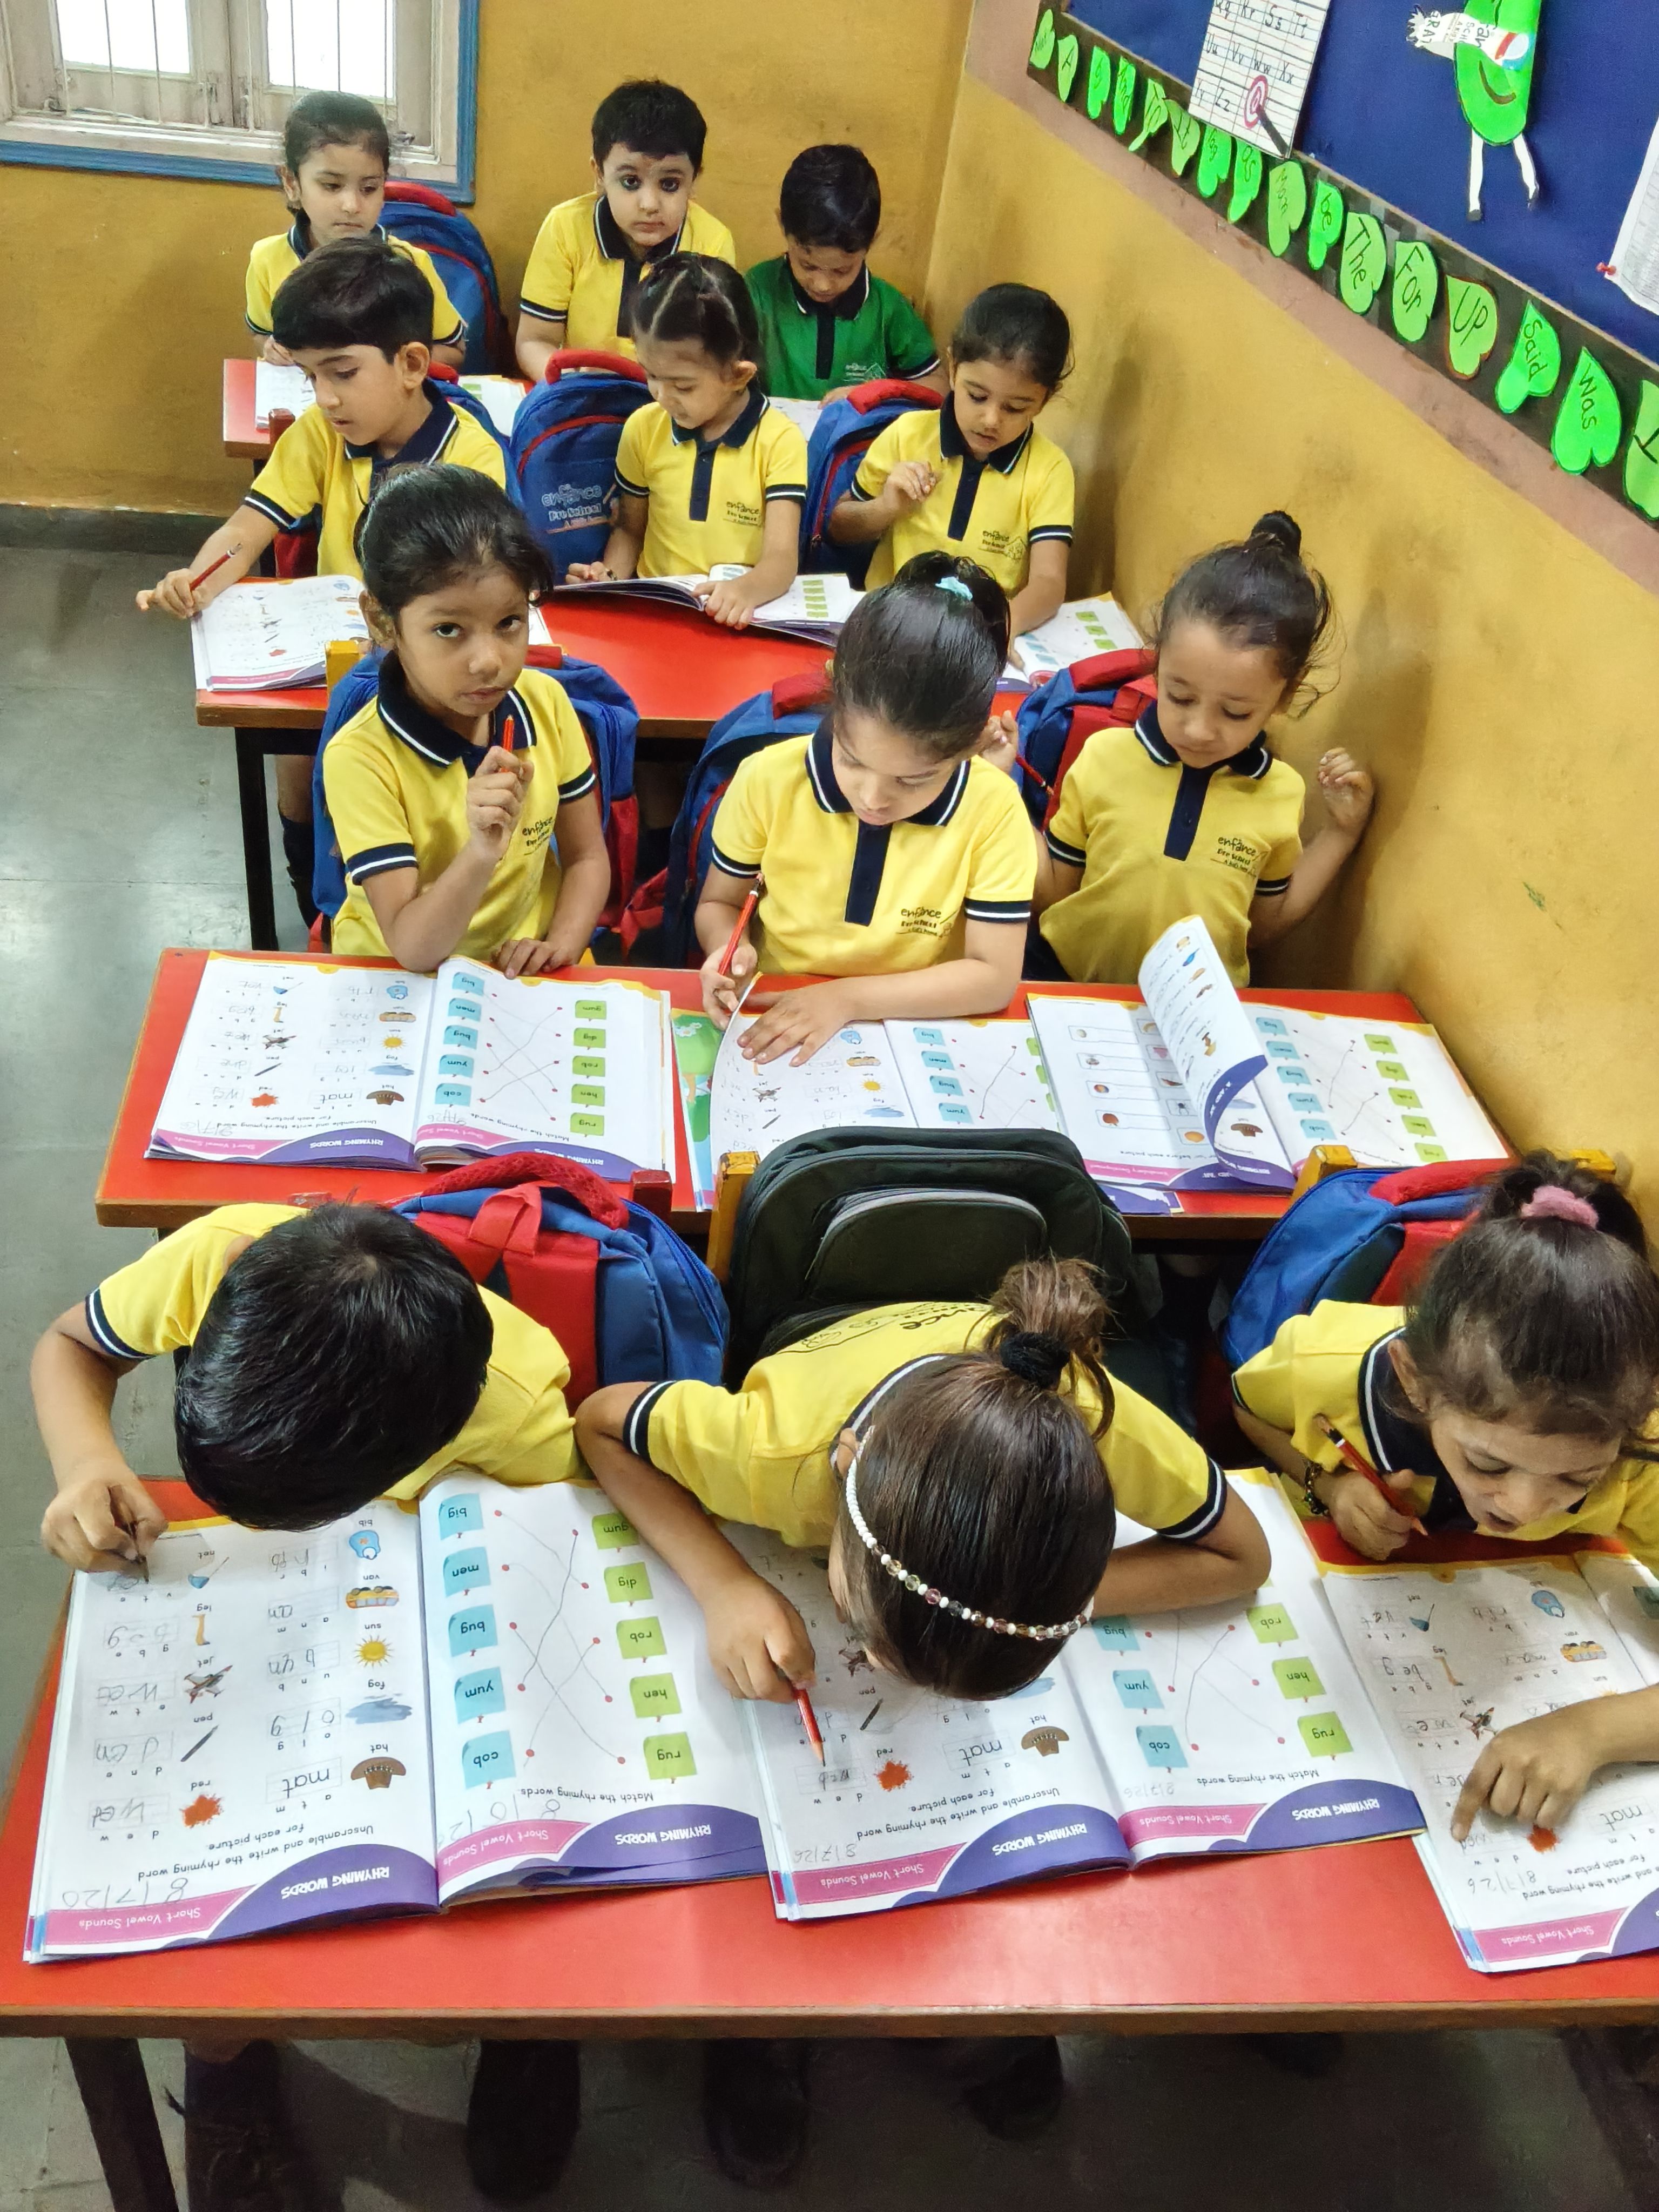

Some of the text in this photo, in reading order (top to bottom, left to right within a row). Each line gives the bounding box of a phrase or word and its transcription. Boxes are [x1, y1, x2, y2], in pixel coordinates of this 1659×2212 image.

[1265, 4, 1283, 30] Ss
[1293, 12, 1309, 39] Tt
[1279, 62, 1295, 84] Xx
[1215, 86, 1230, 112] Zz
[1320, 192, 1333, 232] be
[1345, 216, 1372, 291] The
[1395, 245, 1424, 314] For
[1523, 319, 1548, 382] Said
[1578, 362, 1598, 431] Was
[462, 978, 476, 988] big
[456, 1005, 476, 1014] men
[453, 1029, 471, 1041] bug
[583, 1033, 598, 1041] dig
[319, 1092, 353, 1104] mat
[580, 1091, 598, 1099] hen
[470, 1112, 494, 1122] words
[497, 1120, 528, 1132] rhyming
[579, 1120, 597, 1128] rug
[544, 1132, 569, 1142] Match
[447, 1506, 468, 1520] big
[358, 1519, 373, 1527] bib
[603, 1522, 629, 1535] gum
[198, 1550, 215, 1559] net
[451, 1564, 480, 1578] men
[617, 1576, 637, 1589] dig
[197, 1603, 212, 1613] leg
[460, 1620, 487, 1636] bug
[1260, 1617, 1282, 1629] rob
[630, 1631, 652, 1643] rob
[1103, 1625, 1127, 1638] bug
[1432, 1645, 1447, 1656] leg
[197, 1656, 214, 1668] jet
[1286, 1671, 1311, 1682] hen
[367, 1679, 385, 1690] fog
[464, 1680, 495, 1700] yum
[859, 1686, 876, 1696] pen
[1124, 1680, 1149, 1691] yum
[643, 1688, 668, 1701] hen
[193, 1712, 213, 1724] pen
[1030, 1715, 1047, 1725] hat
[1311, 1728, 1335, 1740] rug
[370, 1743, 388, 1754] hat
[876, 1748, 893, 1757] red
[959, 1739, 1003, 1767] mat
[1149, 1742, 1170, 1753] cob
[473, 1750, 499, 1767] cob
[657, 1749, 681, 1762] rug
[190, 1779, 211, 1791] red
[281, 1769, 329, 1799] mat
[1197, 1769, 1320, 1788] Match the rhyming words
[519, 1787, 654, 1803] Match the rhyming words
[950, 1793, 974, 1805] each
[977, 1788, 995, 1797] for
[857, 1787, 1060, 1841] Unscramble and write the rhyming word
[1291, 1798, 1380, 1822] RHYMING WORDS
[1139, 1813, 1233, 1827] Short Vowel Sounds
[1600, 1805, 1643, 1832] mat
[254, 1823, 305, 1844] for each
[615, 1824, 711, 1846] RHYMING WORDS
[992, 1823, 1088, 1856] RHYMING WORDS
[138, 1823, 374, 1880] Unscramble and write the rhyming word
[442, 1829, 549, 1867] Short Vowel Sounds
[1602, 1853, 1645, 1869] for each
[820, 1863, 924, 1888] Short Vowel Sounds
[280, 1866, 390, 1900] RHYMING WORDS
[1522, 1868, 1653, 1900] and write the rhyming word
[78, 1906, 201, 1930] Short Vowel Sounds
[1500, 1924, 1595, 1947] Short Vowel Sounds
